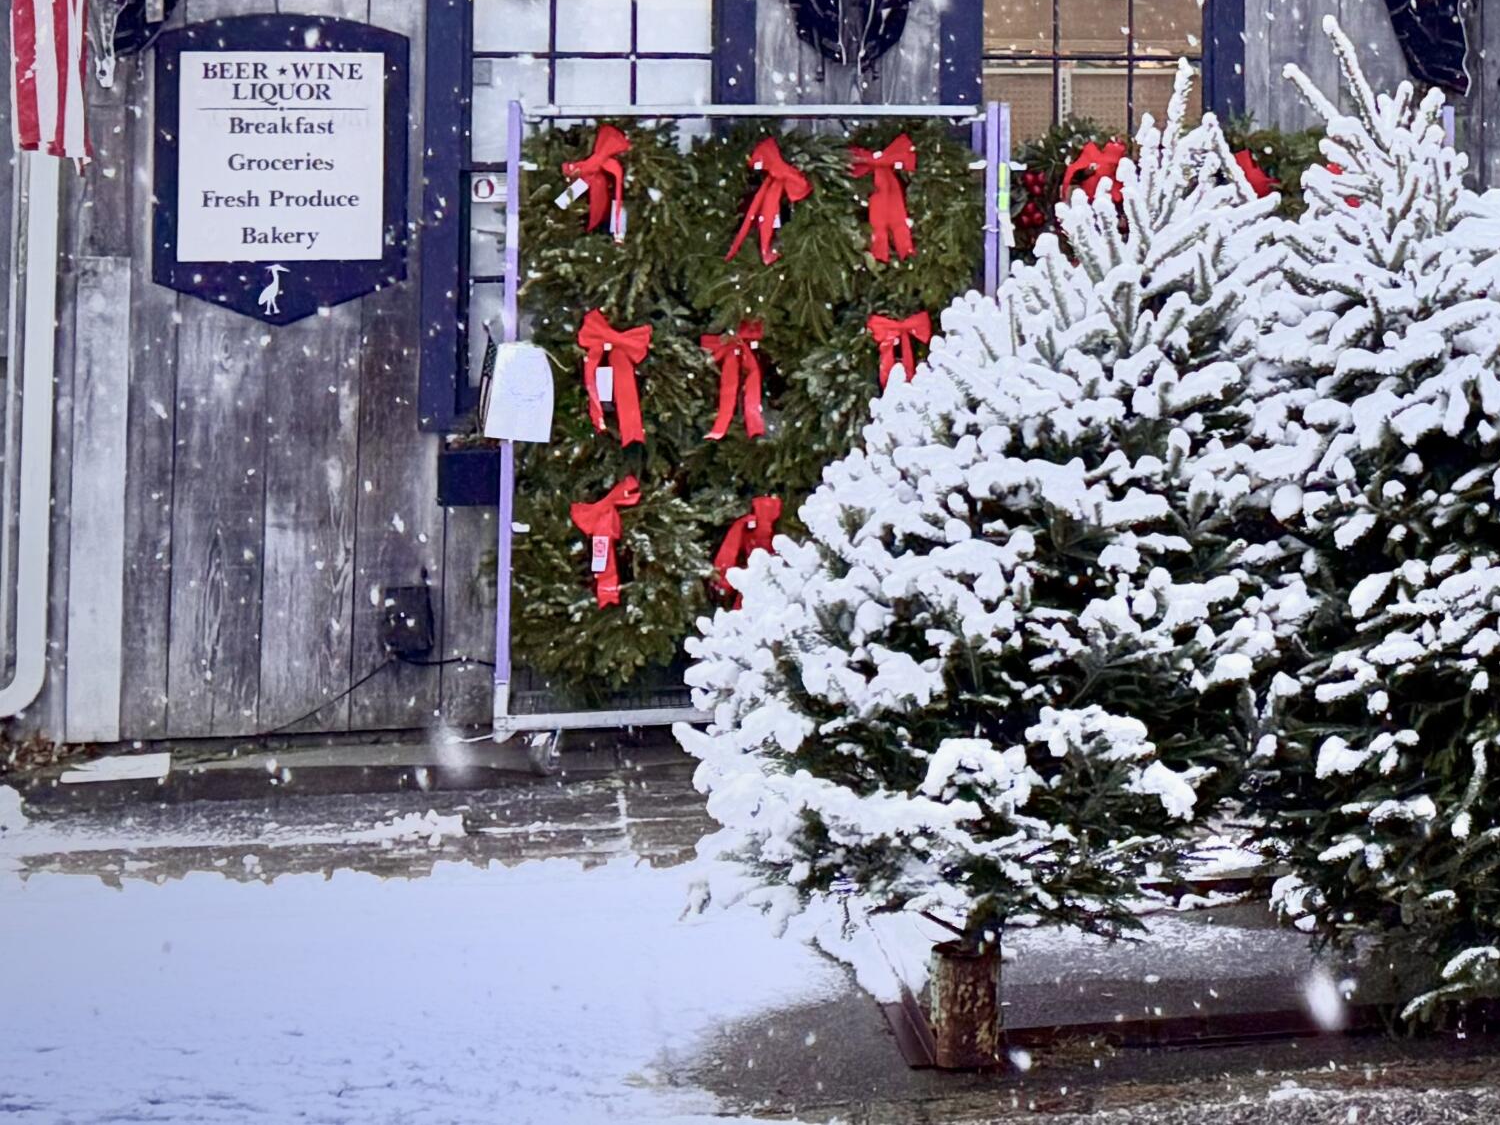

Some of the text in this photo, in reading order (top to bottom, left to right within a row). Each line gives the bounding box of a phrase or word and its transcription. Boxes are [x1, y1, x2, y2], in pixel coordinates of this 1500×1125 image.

[202, 62, 363, 80] BEER WINE
[232, 82, 332, 106] LIQUOR
[228, 116, 335, 135] Breakfast
[227, 152, 335, 171] Groceries
[201, 189, 360, 208] Fresh Produce
[241, 226, 320, 250] Bakery
